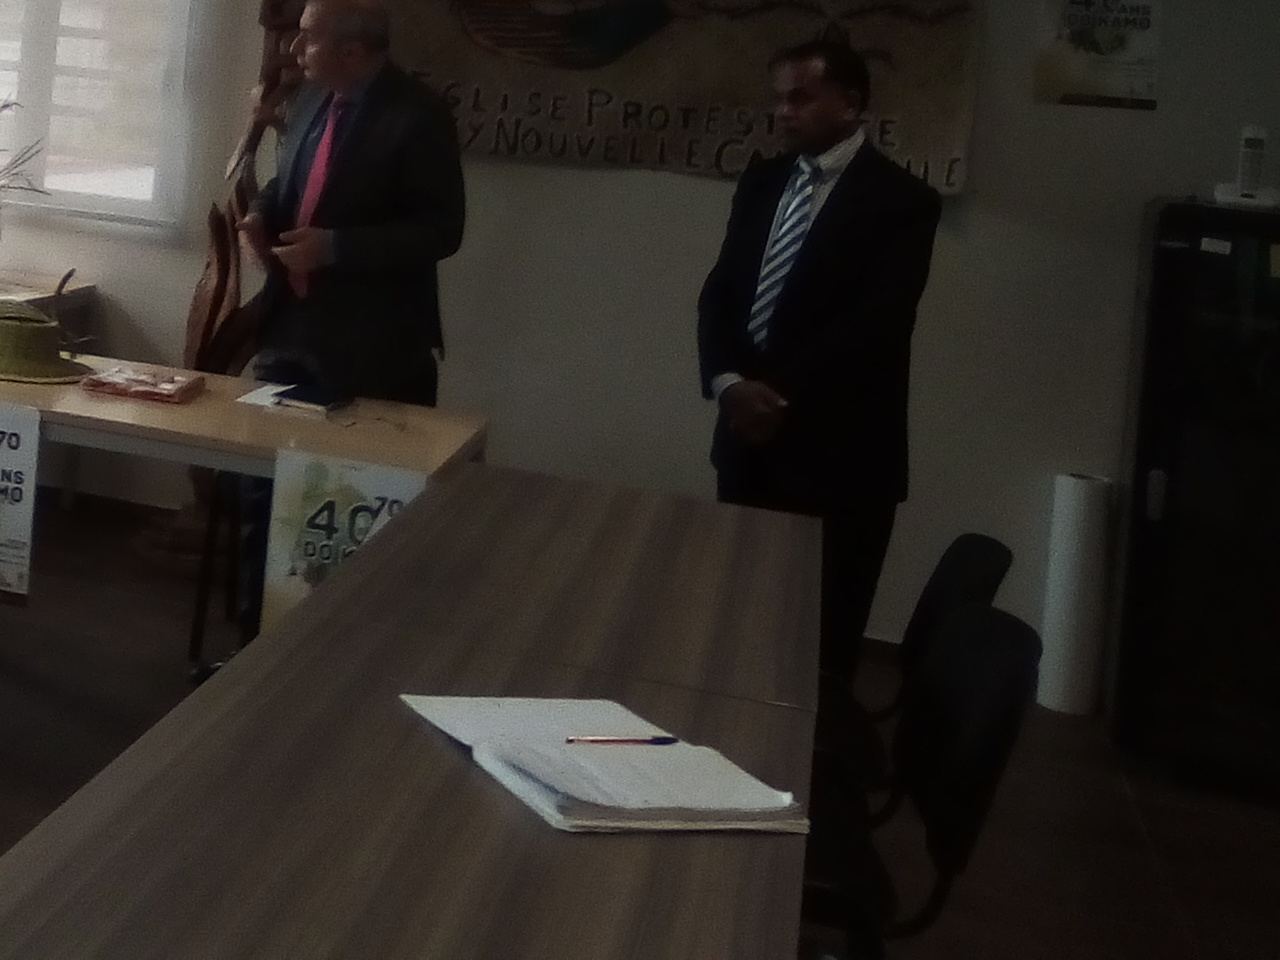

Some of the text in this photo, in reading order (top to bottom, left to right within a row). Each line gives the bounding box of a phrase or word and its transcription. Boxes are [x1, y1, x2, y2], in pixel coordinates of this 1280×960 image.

[1117, 4, 1151, 16] ANS
[1098, 16, 1151, 31] KAMO
[412, 71, 567, 121] GLISE
[303, 541, 332, 561] DO
